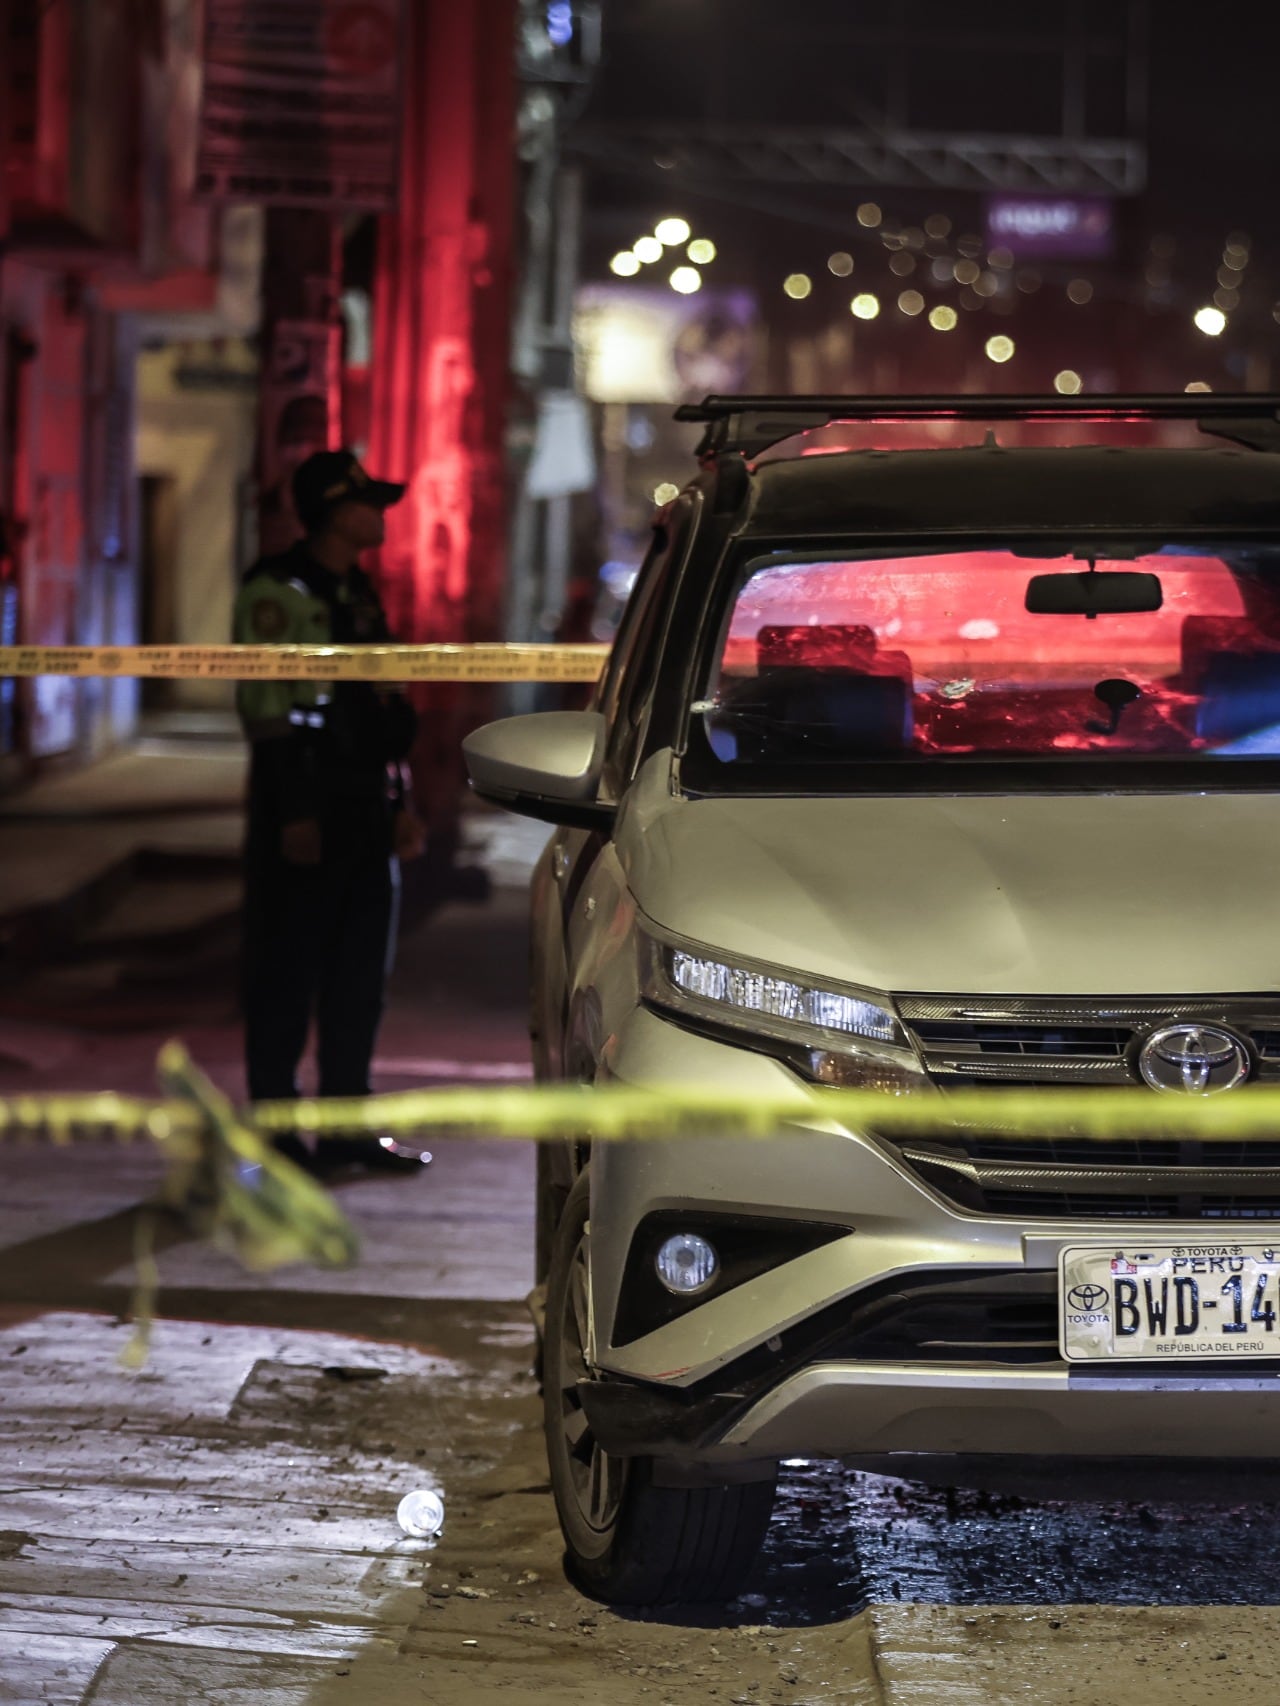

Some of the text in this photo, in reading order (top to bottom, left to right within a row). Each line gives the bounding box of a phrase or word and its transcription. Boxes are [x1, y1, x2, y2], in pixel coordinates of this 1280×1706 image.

[1187, 1247, 1228, 1256] TOYOTA
[1067, 1314, 1110, 1324] TOYOTA
[1156, 1341, 1264, 1353] REPÚBLICA DEL PERÚ
